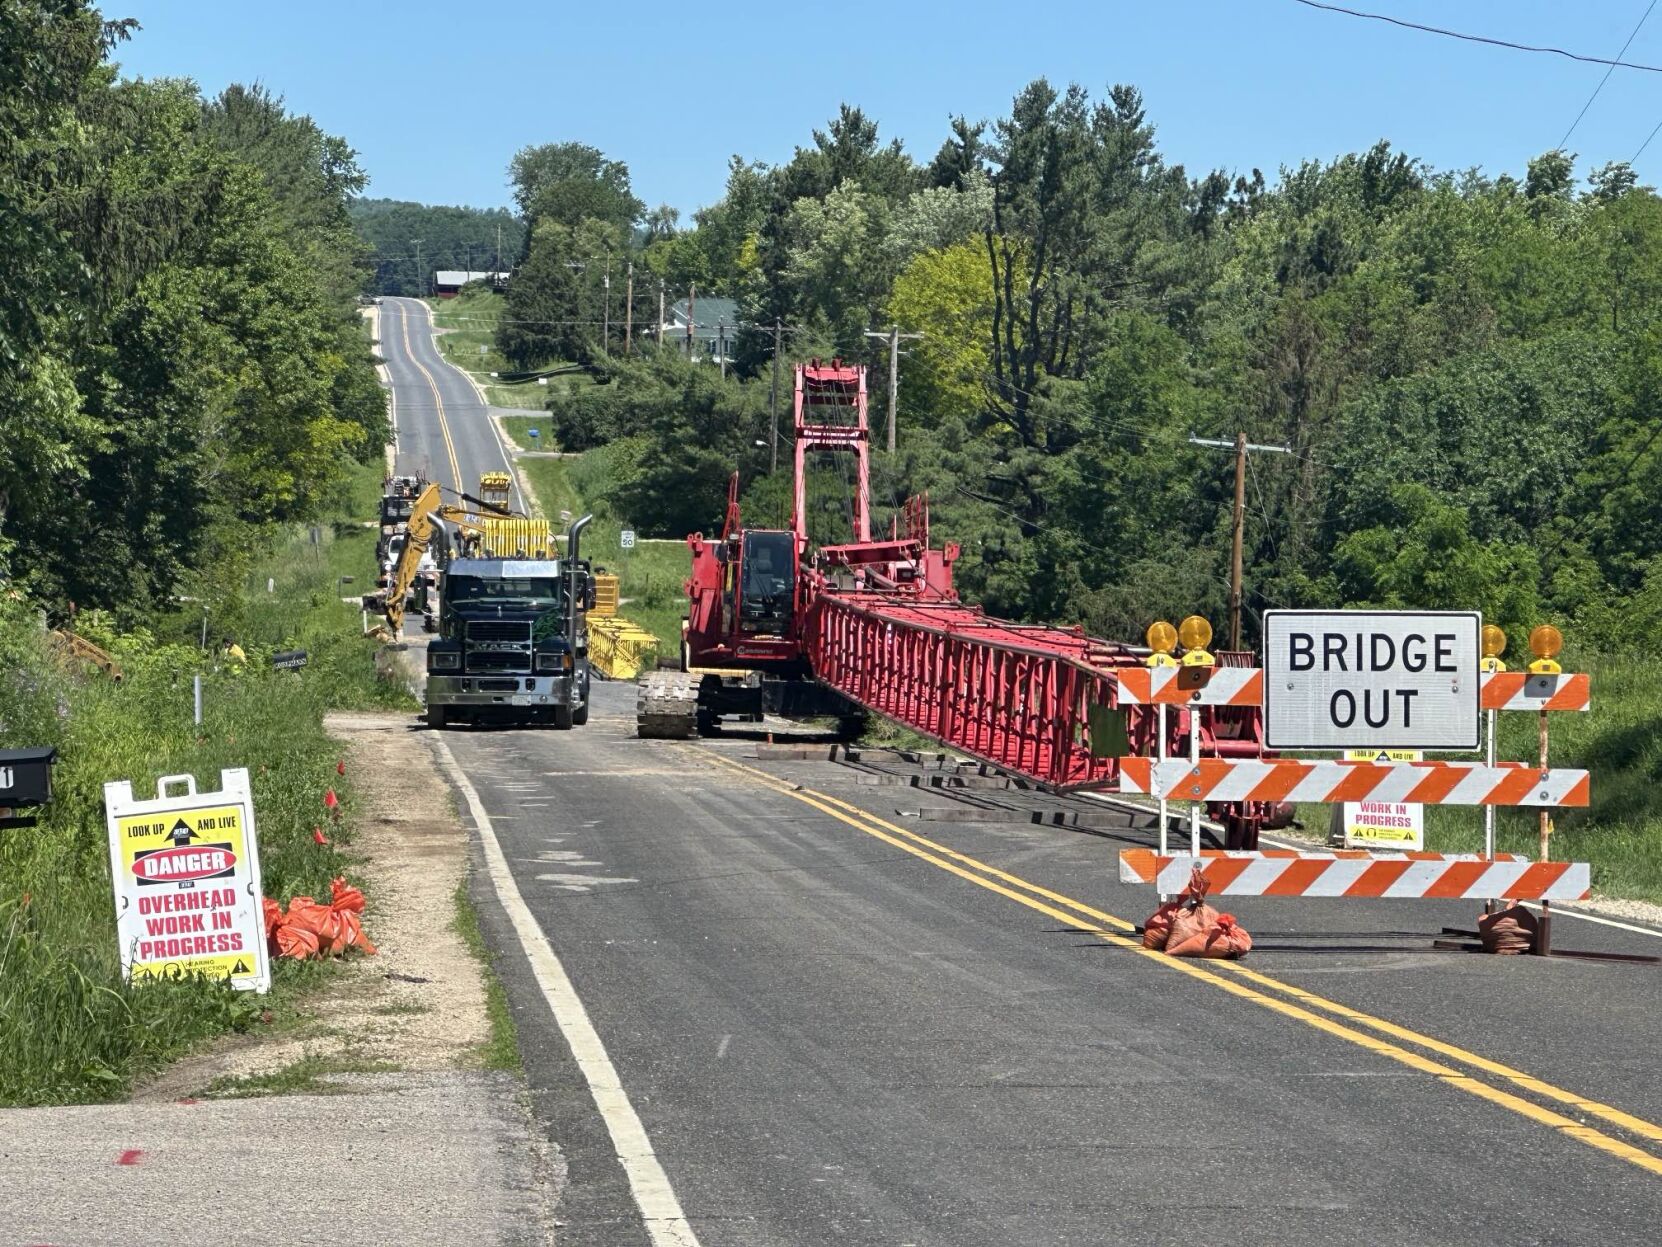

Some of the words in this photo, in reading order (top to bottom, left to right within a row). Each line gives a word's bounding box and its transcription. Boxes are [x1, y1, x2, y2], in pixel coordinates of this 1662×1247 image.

[473, 643, 522, 651] MACK
[1289, 632, 1458, 673] BRIDGE
[1329, 689, 1419, 729] OUT
[1368, 750, 1375, 758] UP
[1404, 753, 1414, 761] LIVE
[1360, 802, 1392, 814] WORK
[1396, 804, 1407, 815] IN
[128, 824, 151, 838] LOOK
[152, 823, 165, 836] UP
[197, 818, 216, 831] AND
[218, 816, 236, 829] LIVE
[1355, 814, 1411, 828] PROGRESS
[144, 852, 226, 876] DANGER
[139, 889, 236, 915] OVERHEAD
[146, 914, 205, 936] WORK
[212, 911, 232, 929] IN
[141, 933, 243, 959] PROGRESS
